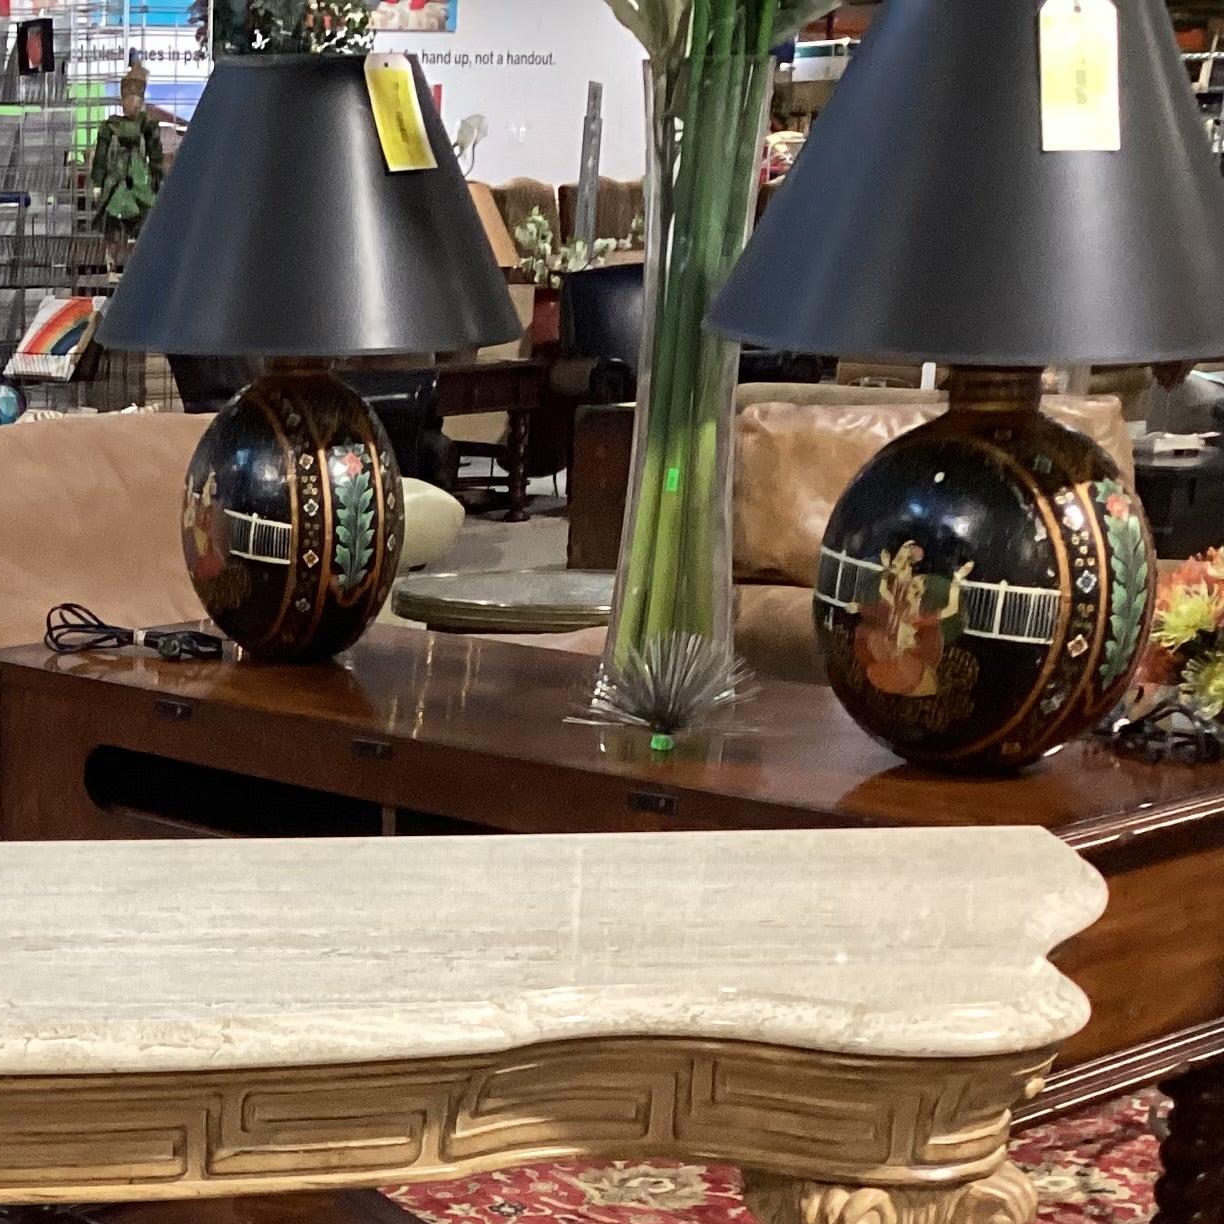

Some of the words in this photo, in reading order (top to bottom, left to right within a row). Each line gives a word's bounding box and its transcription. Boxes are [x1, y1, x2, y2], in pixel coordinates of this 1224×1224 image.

[422, 49, 451, 64] hand
[454, 52, 472, 68] up,
[475, 51, 494, 65] not
[496, 54, 503, 65] a
[506, 50, 556, 66] handout.
